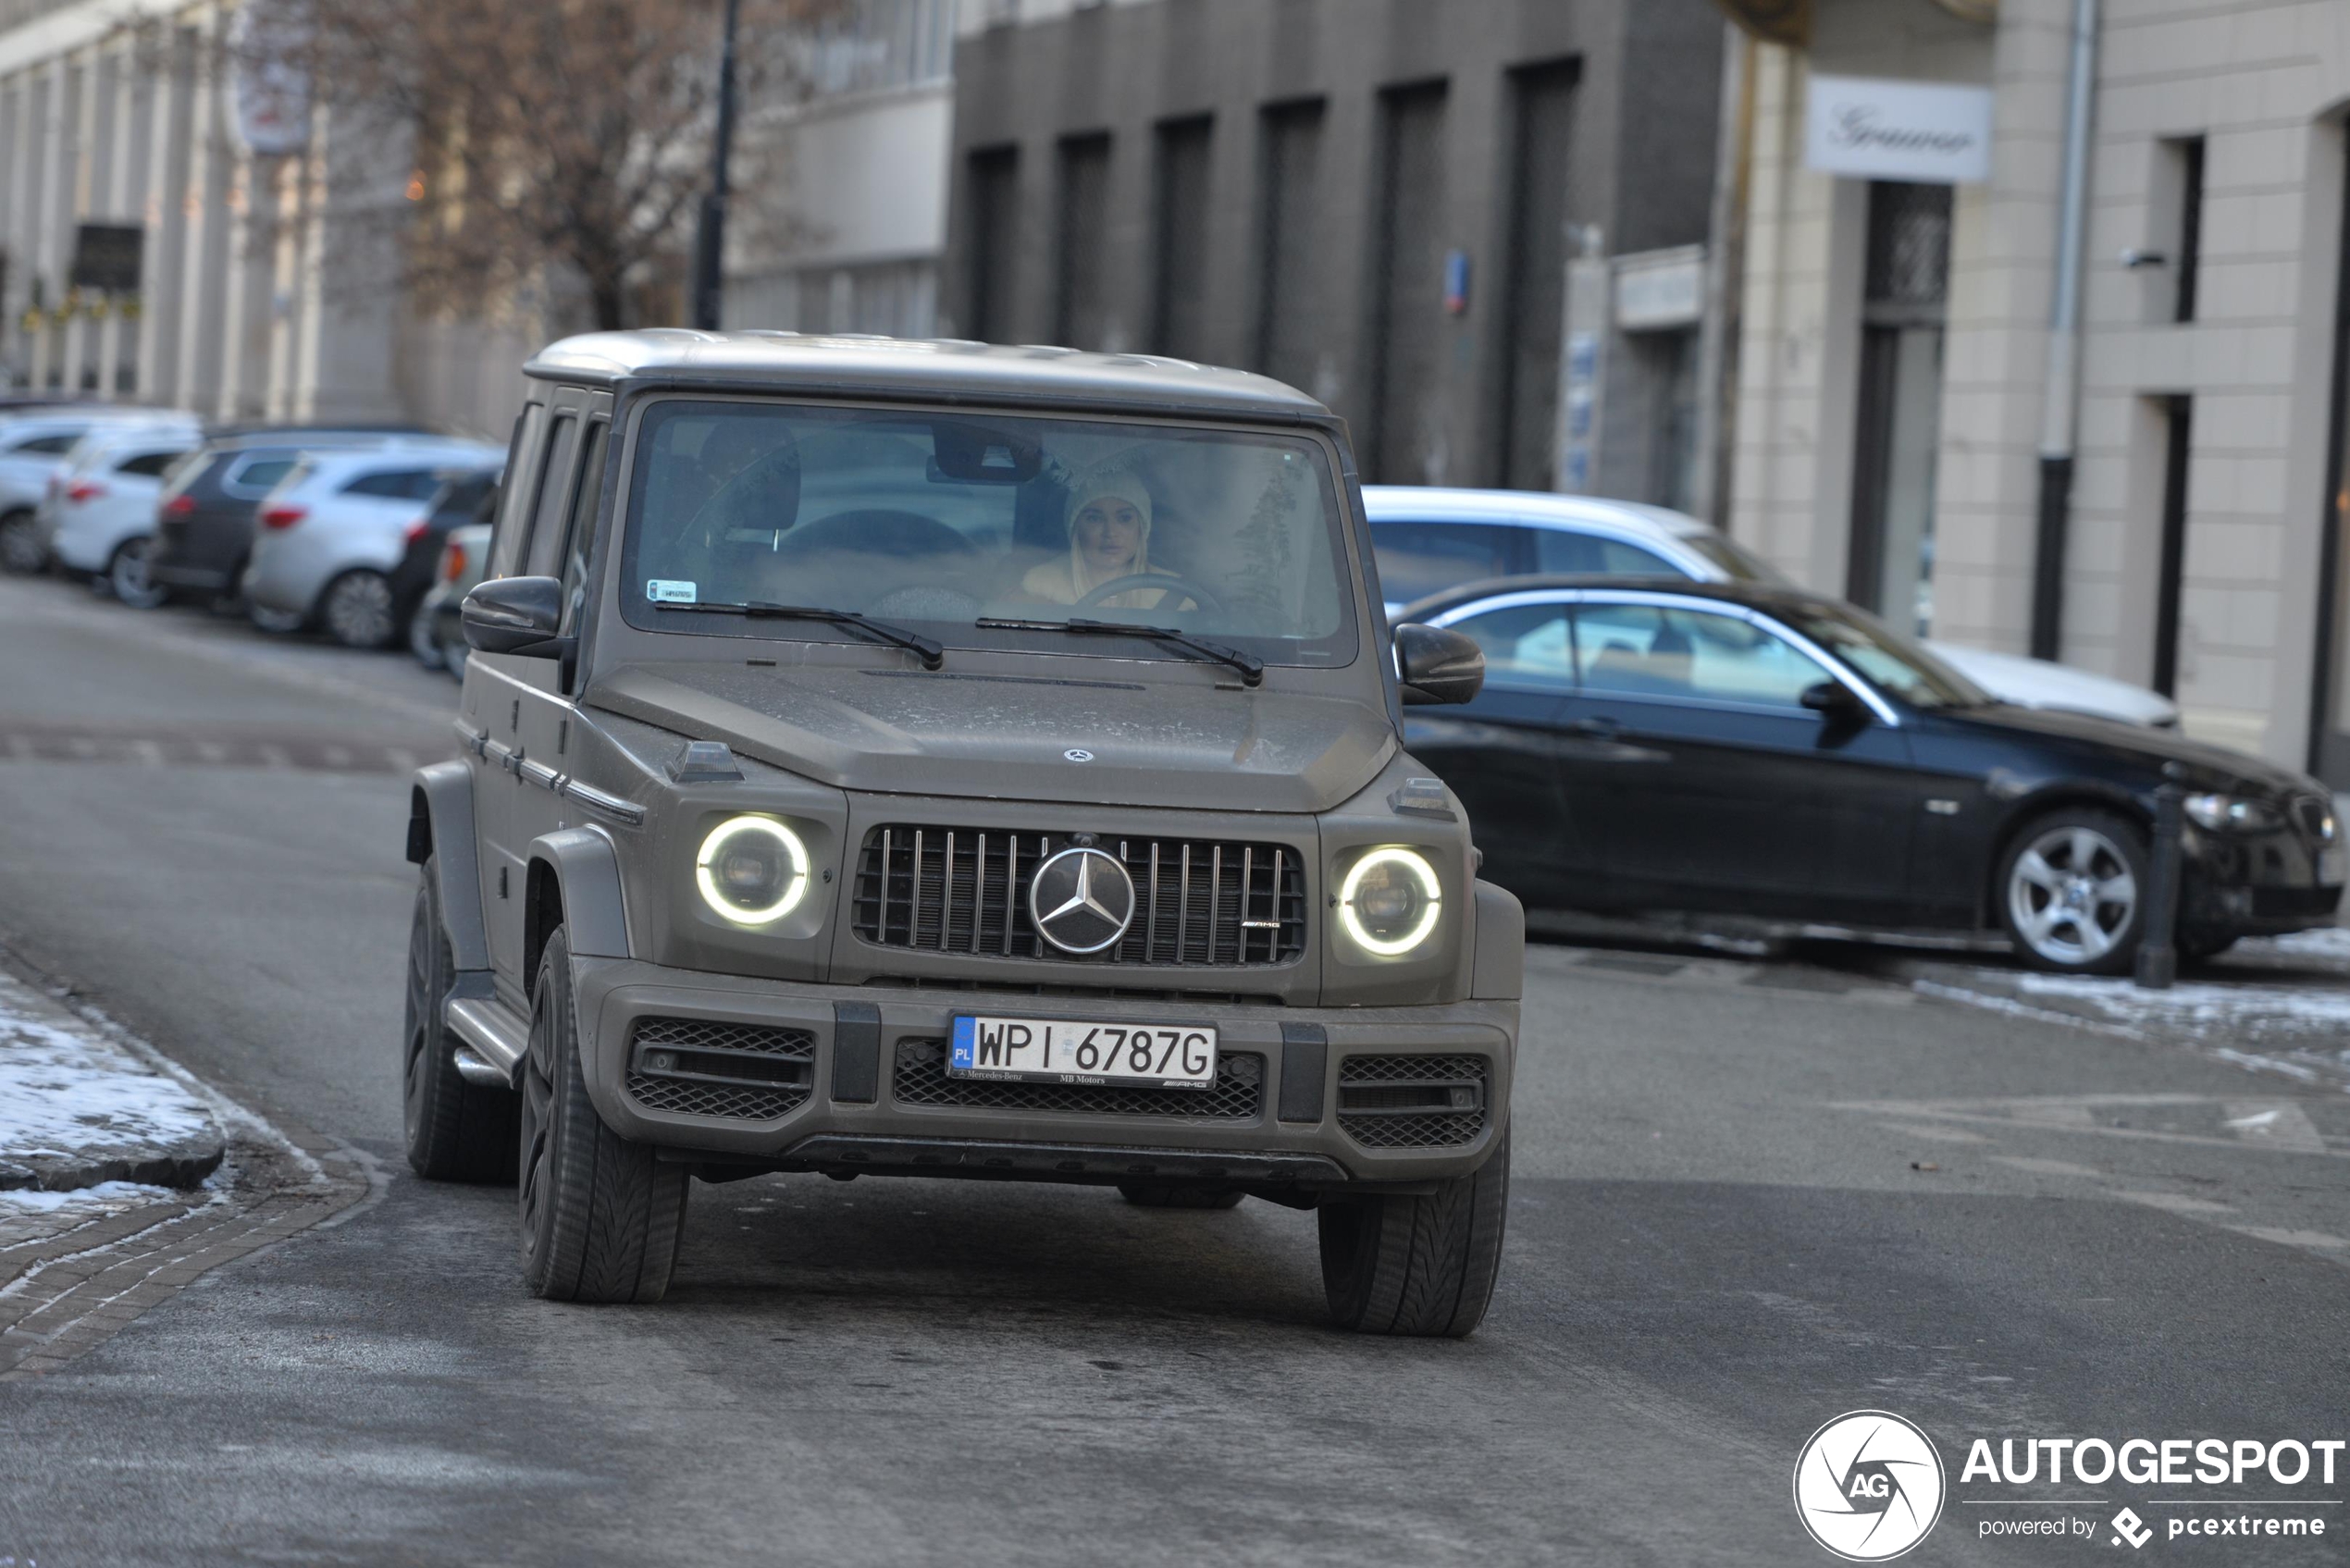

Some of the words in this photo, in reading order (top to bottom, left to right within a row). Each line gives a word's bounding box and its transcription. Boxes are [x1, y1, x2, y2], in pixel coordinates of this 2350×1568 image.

[979, 1022, 1052, 1068] WPI
[1075, 1028, 1208, 1075] 6787G
[955, 1049, 971, 1061] PL
[968, 1070, 1023, 1080] Mercedes-Benz
[1059, 1074, 1075, 1083] MB
[1076, 1075, 1106, 1085] Motors
